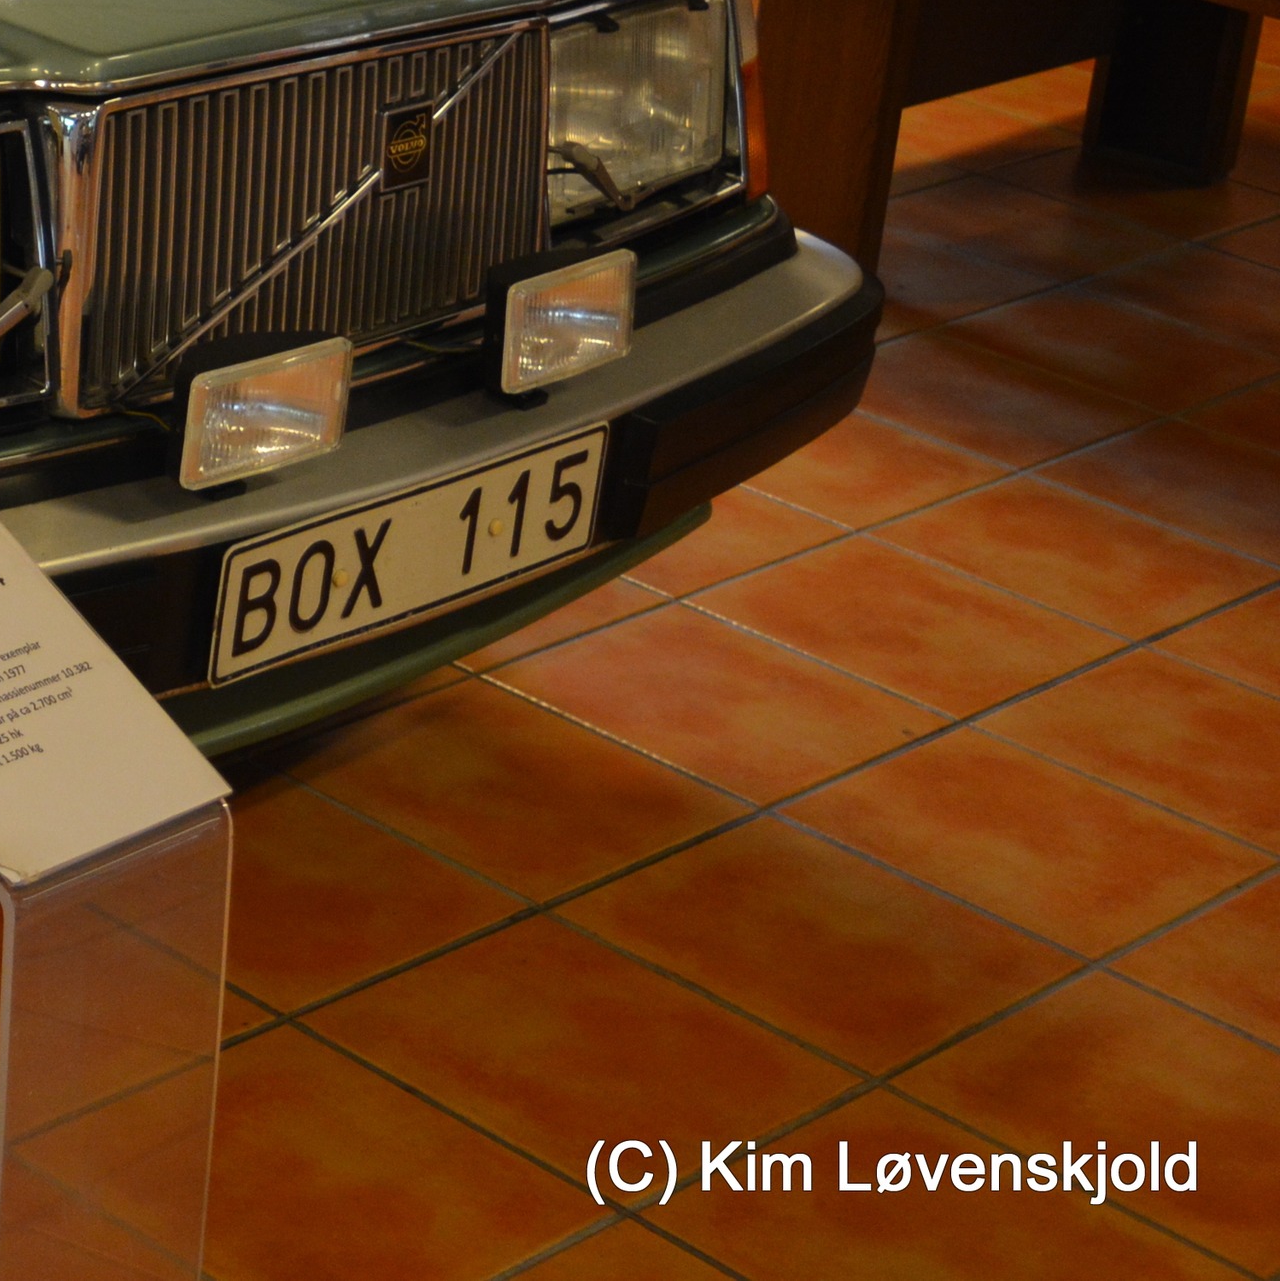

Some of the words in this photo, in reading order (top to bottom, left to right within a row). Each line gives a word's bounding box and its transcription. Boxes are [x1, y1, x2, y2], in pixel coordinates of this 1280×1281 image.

[390, 139, 424, 154] VOLVO
[232, 518, 392, 658] BOX
[459, 449, 589, 576] 115
[0, 640, 41, 662] exemplar
[3, 664, 27, 680] 1977
[7, 708, 19, 722] på
[19, 706, 32, 717] ca
[30, 694, 57, 712] 2.700
[9, 728, 24, 740] hk
[2, 748, 30, 764] 1.500
[28, 743, 44, 754] kg
